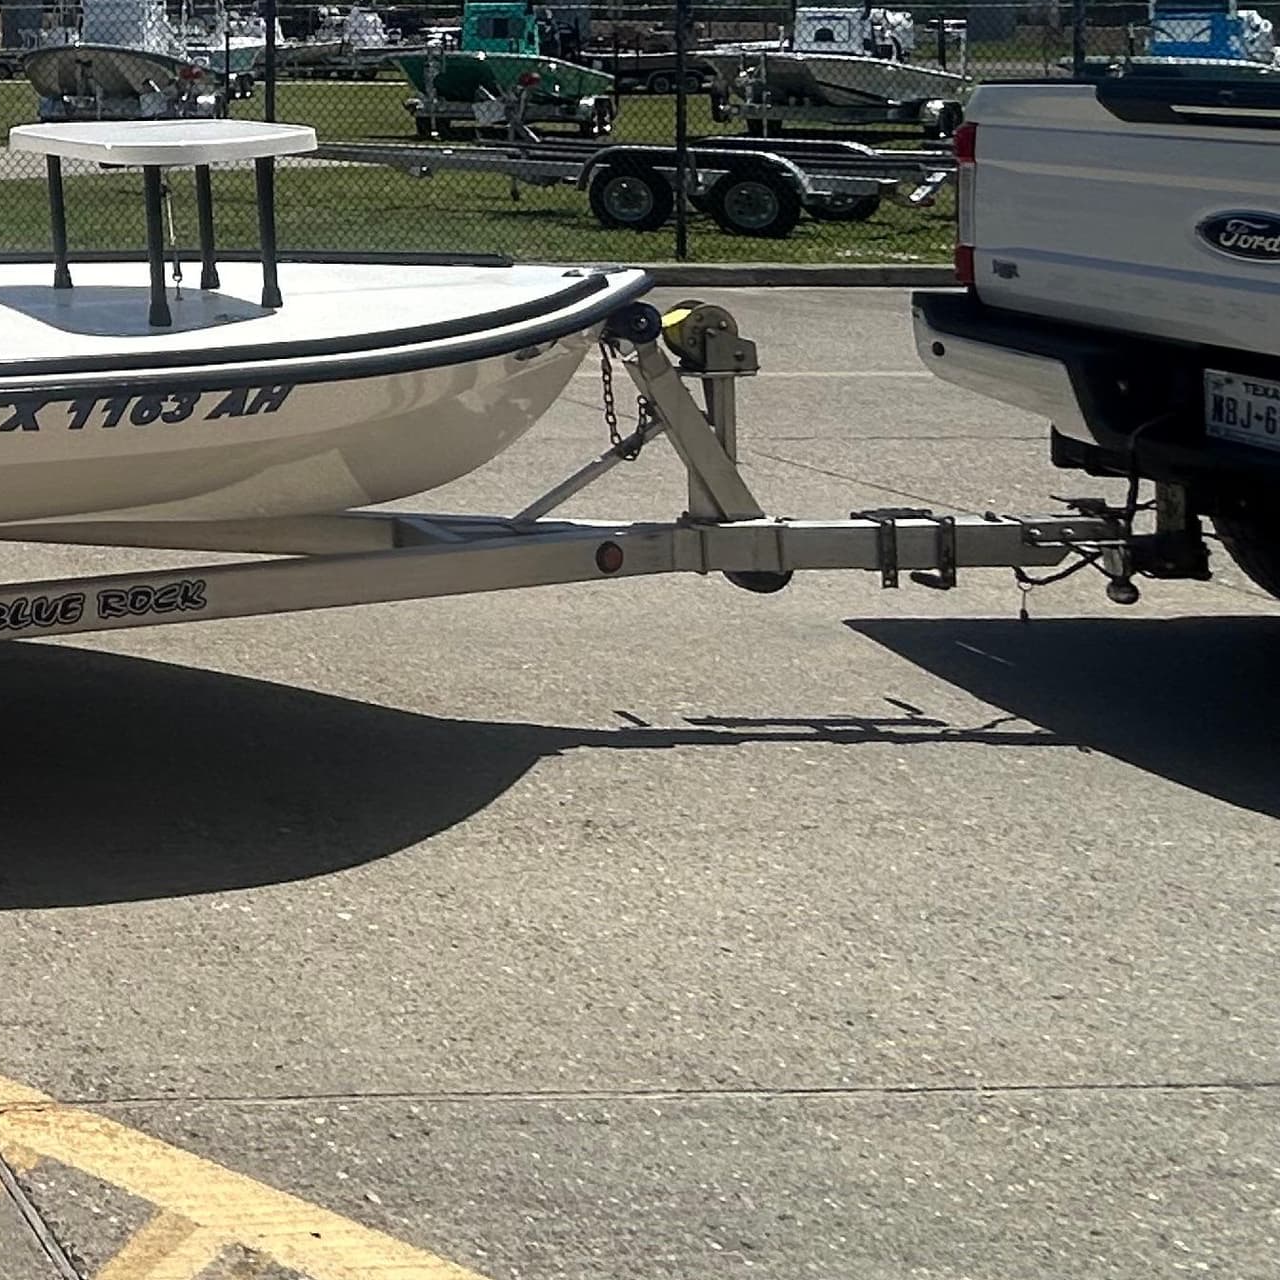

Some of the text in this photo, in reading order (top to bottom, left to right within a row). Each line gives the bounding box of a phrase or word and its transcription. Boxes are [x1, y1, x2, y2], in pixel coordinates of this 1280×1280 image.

[202, 382, 294, 421] AH
[1242, 381, 1280, 401] TEXA
[1211, 393, 1280, 435] NBJ-6
[96, 579, 207, 619] ROCK
